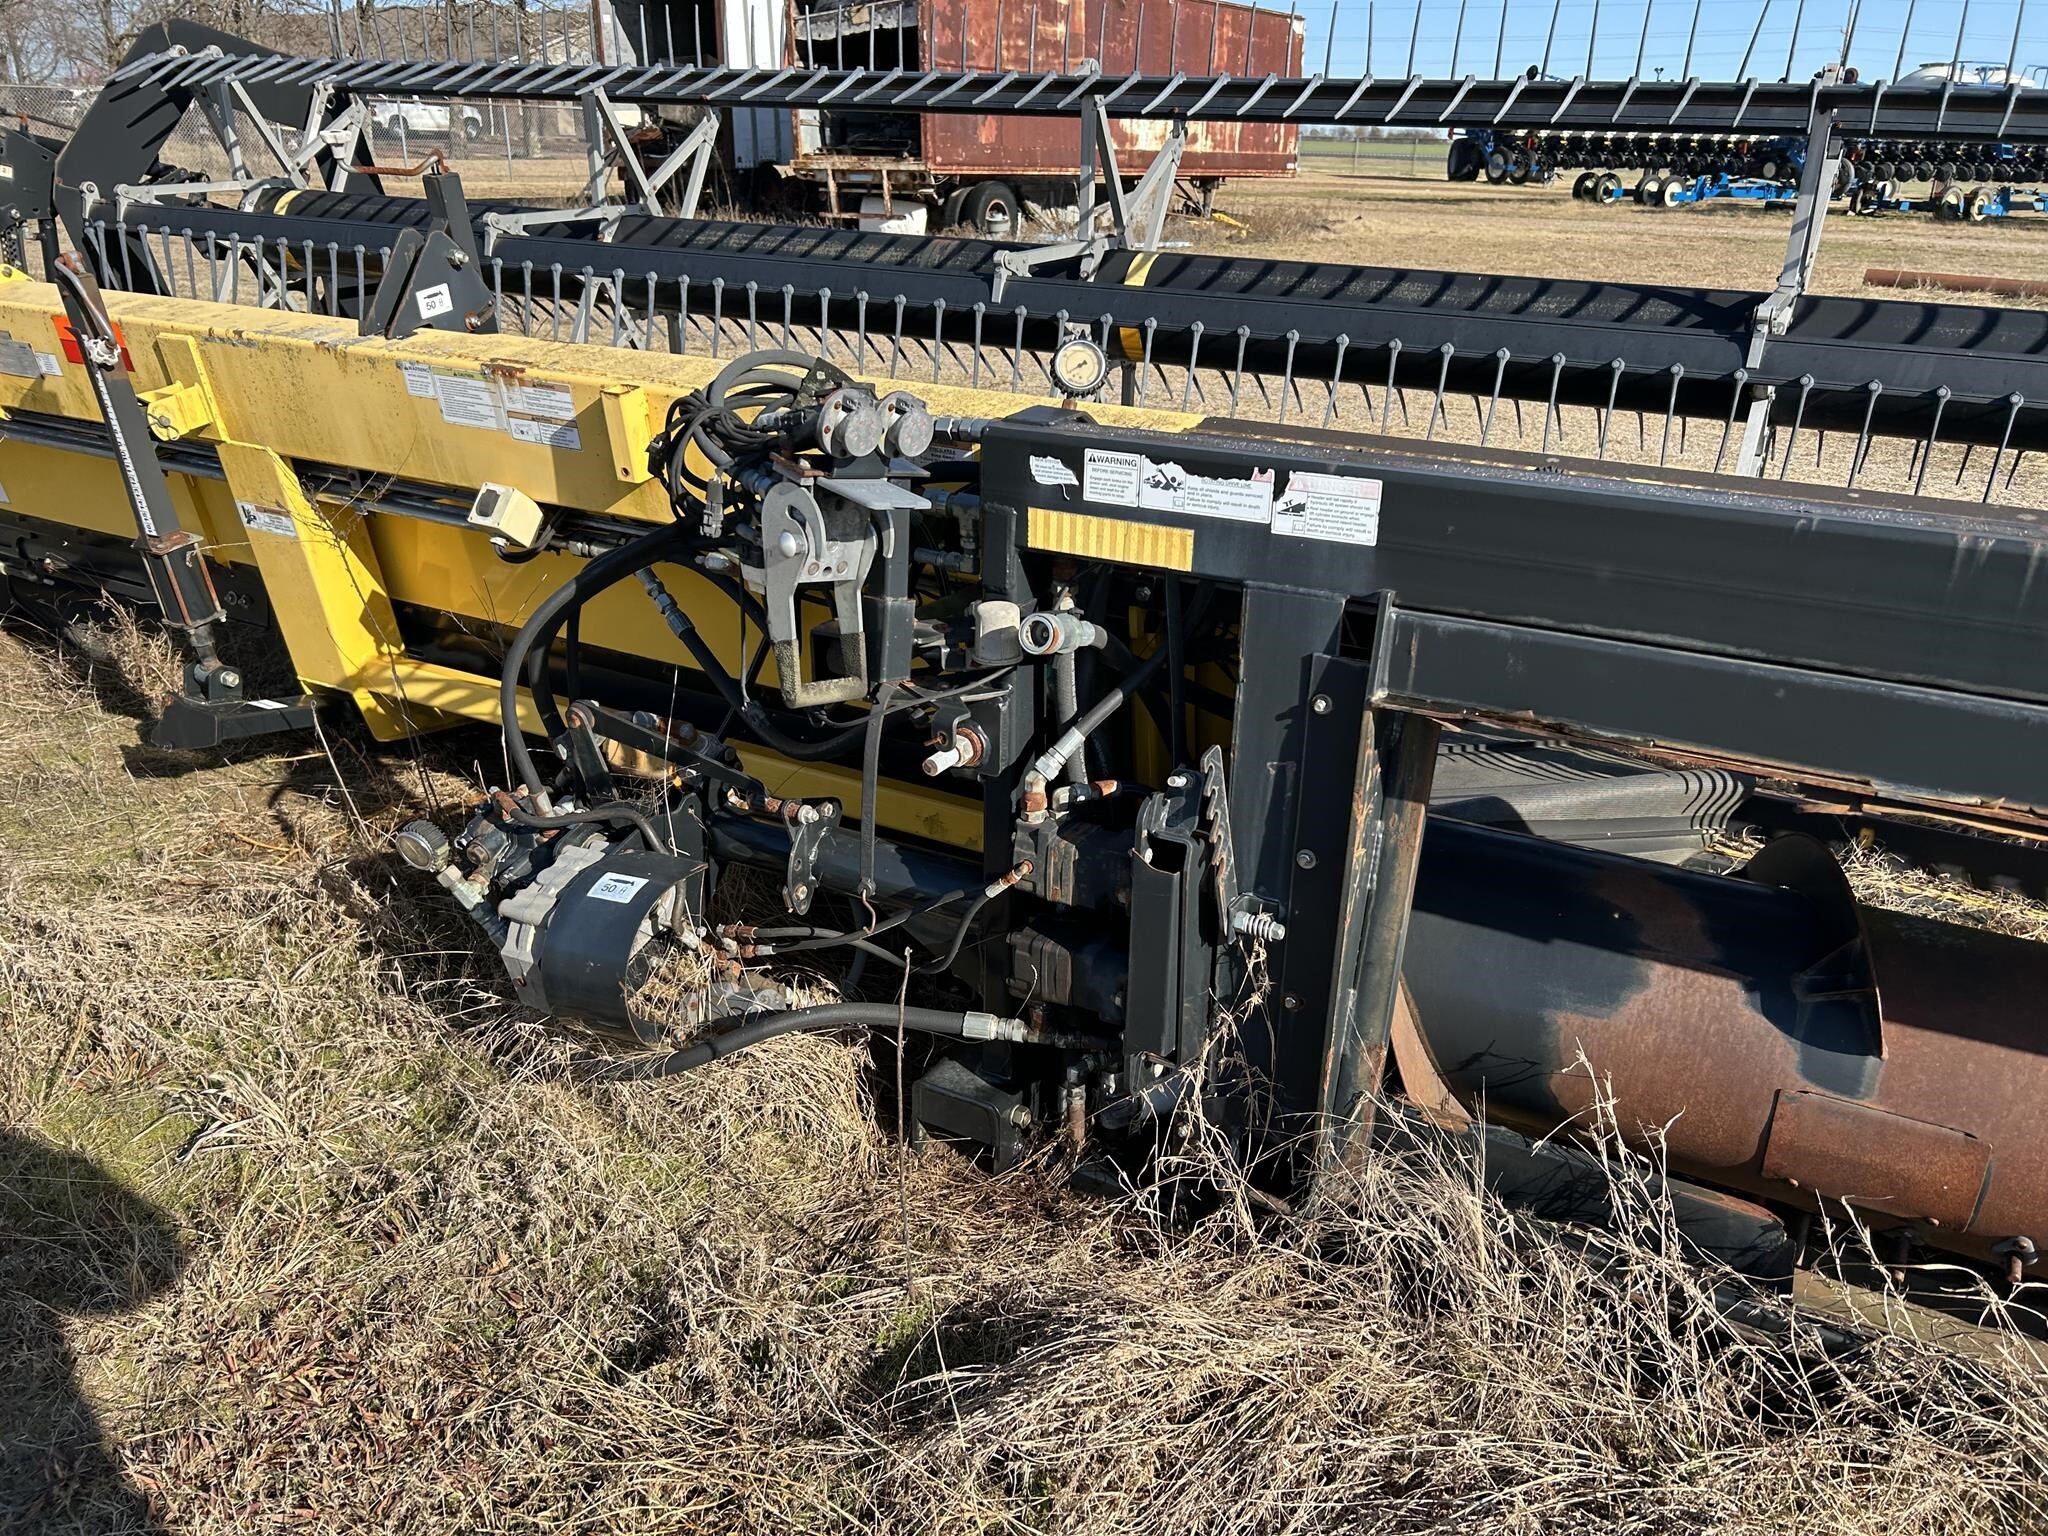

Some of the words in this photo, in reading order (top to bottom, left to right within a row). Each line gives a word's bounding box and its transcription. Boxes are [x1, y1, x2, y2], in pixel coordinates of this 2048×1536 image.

[426, 301, 436, 310] 50
[1096, 454, 1136, 467] WARNING
[601, 884, 617, 892] 50
